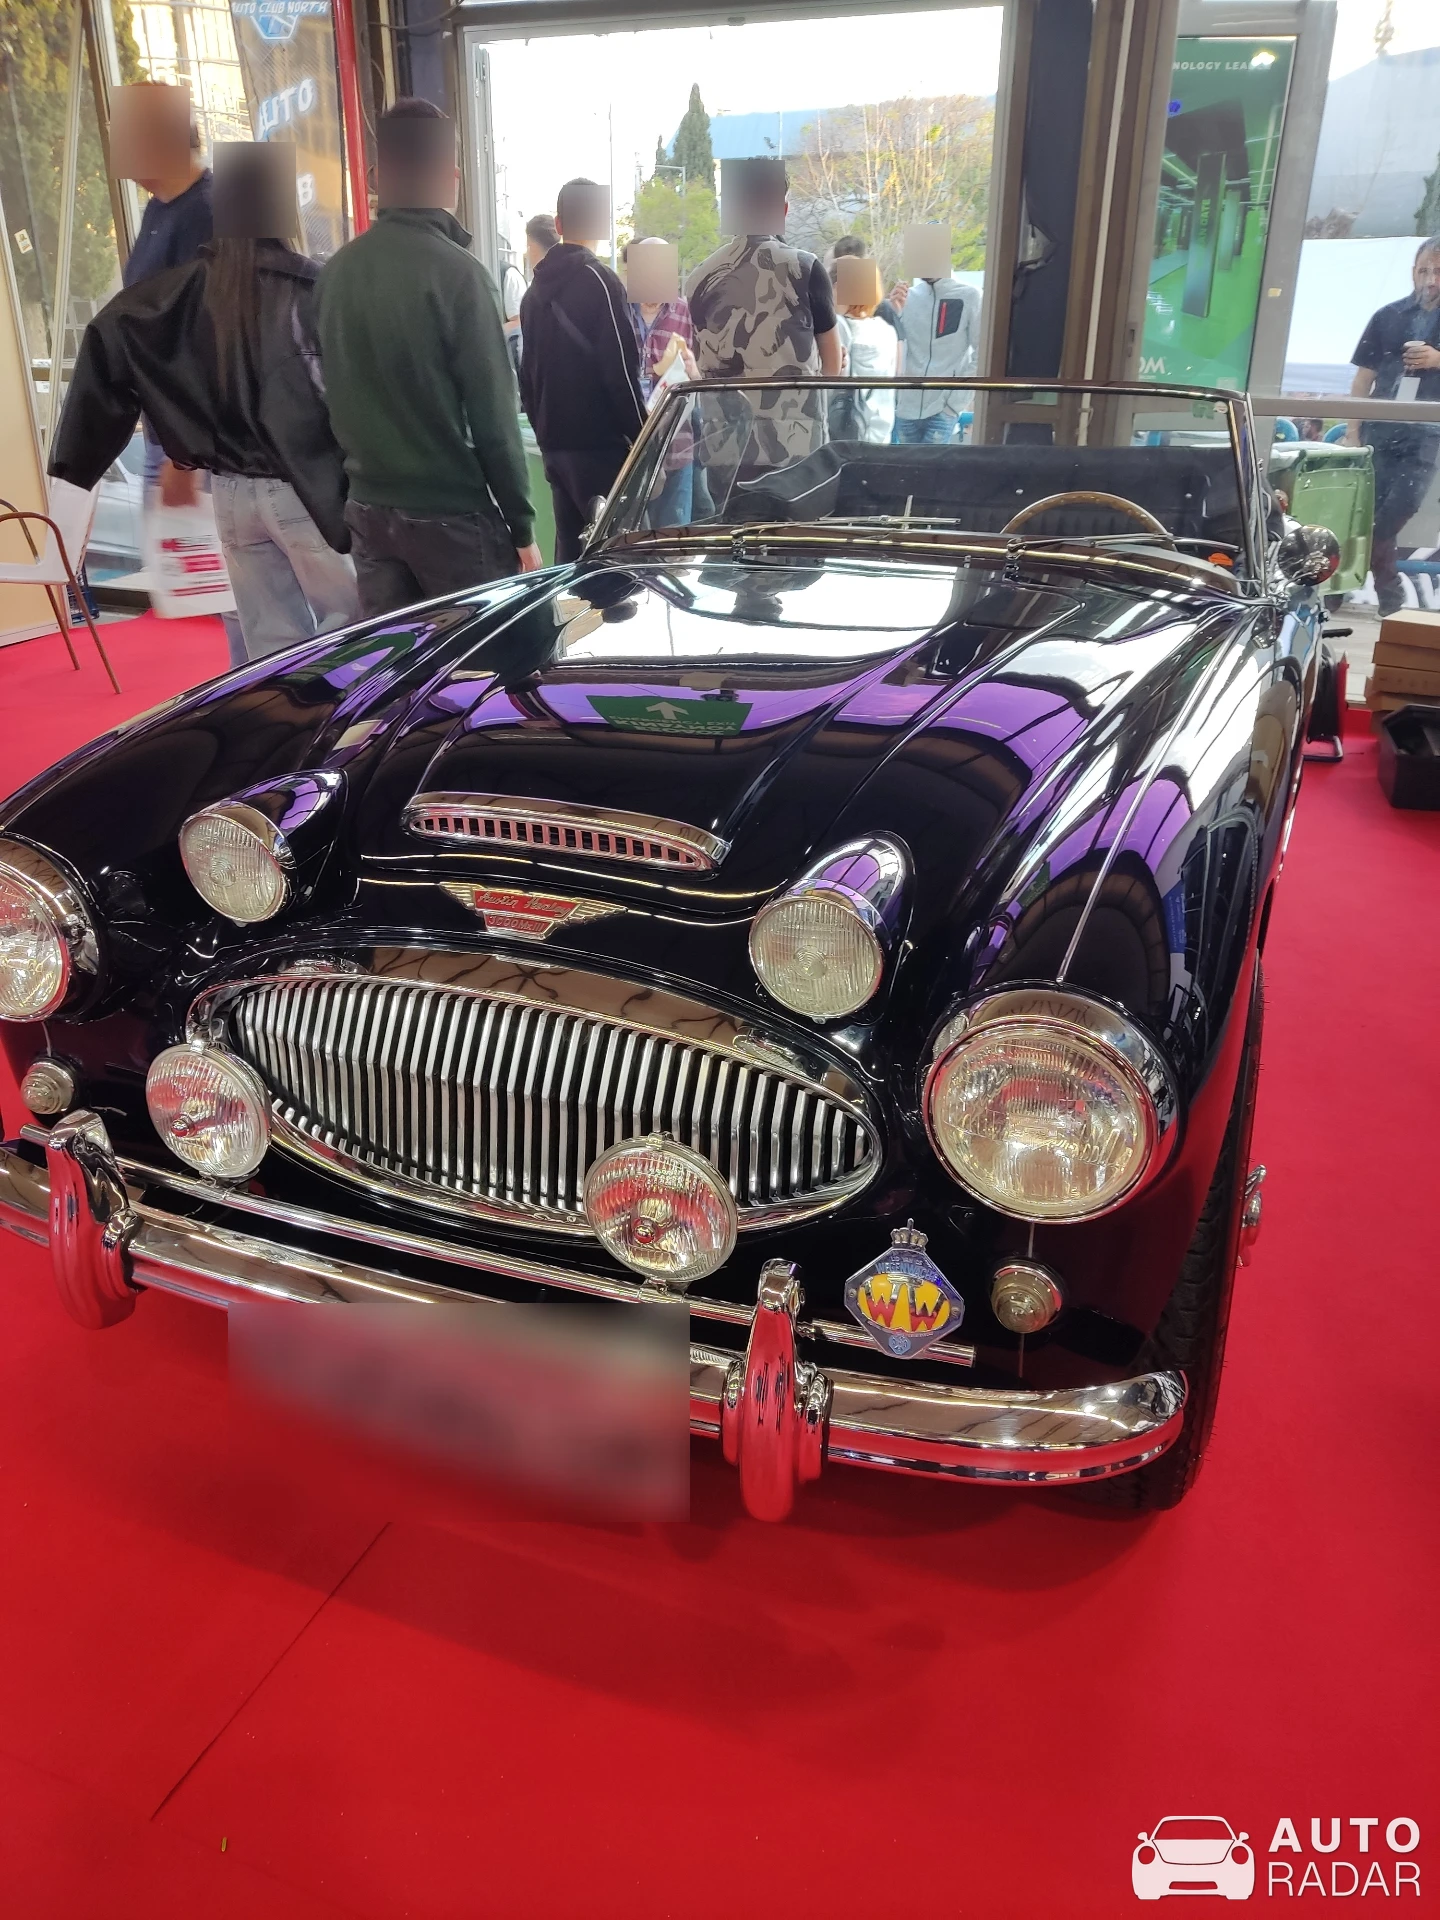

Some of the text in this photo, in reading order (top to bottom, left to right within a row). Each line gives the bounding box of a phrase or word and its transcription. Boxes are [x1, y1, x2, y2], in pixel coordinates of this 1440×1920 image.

[259, 2, 286, 14] CLUB
[1172, 61, 1222, 70] NOLOGY
[478, 891, 519, 908] Austin
